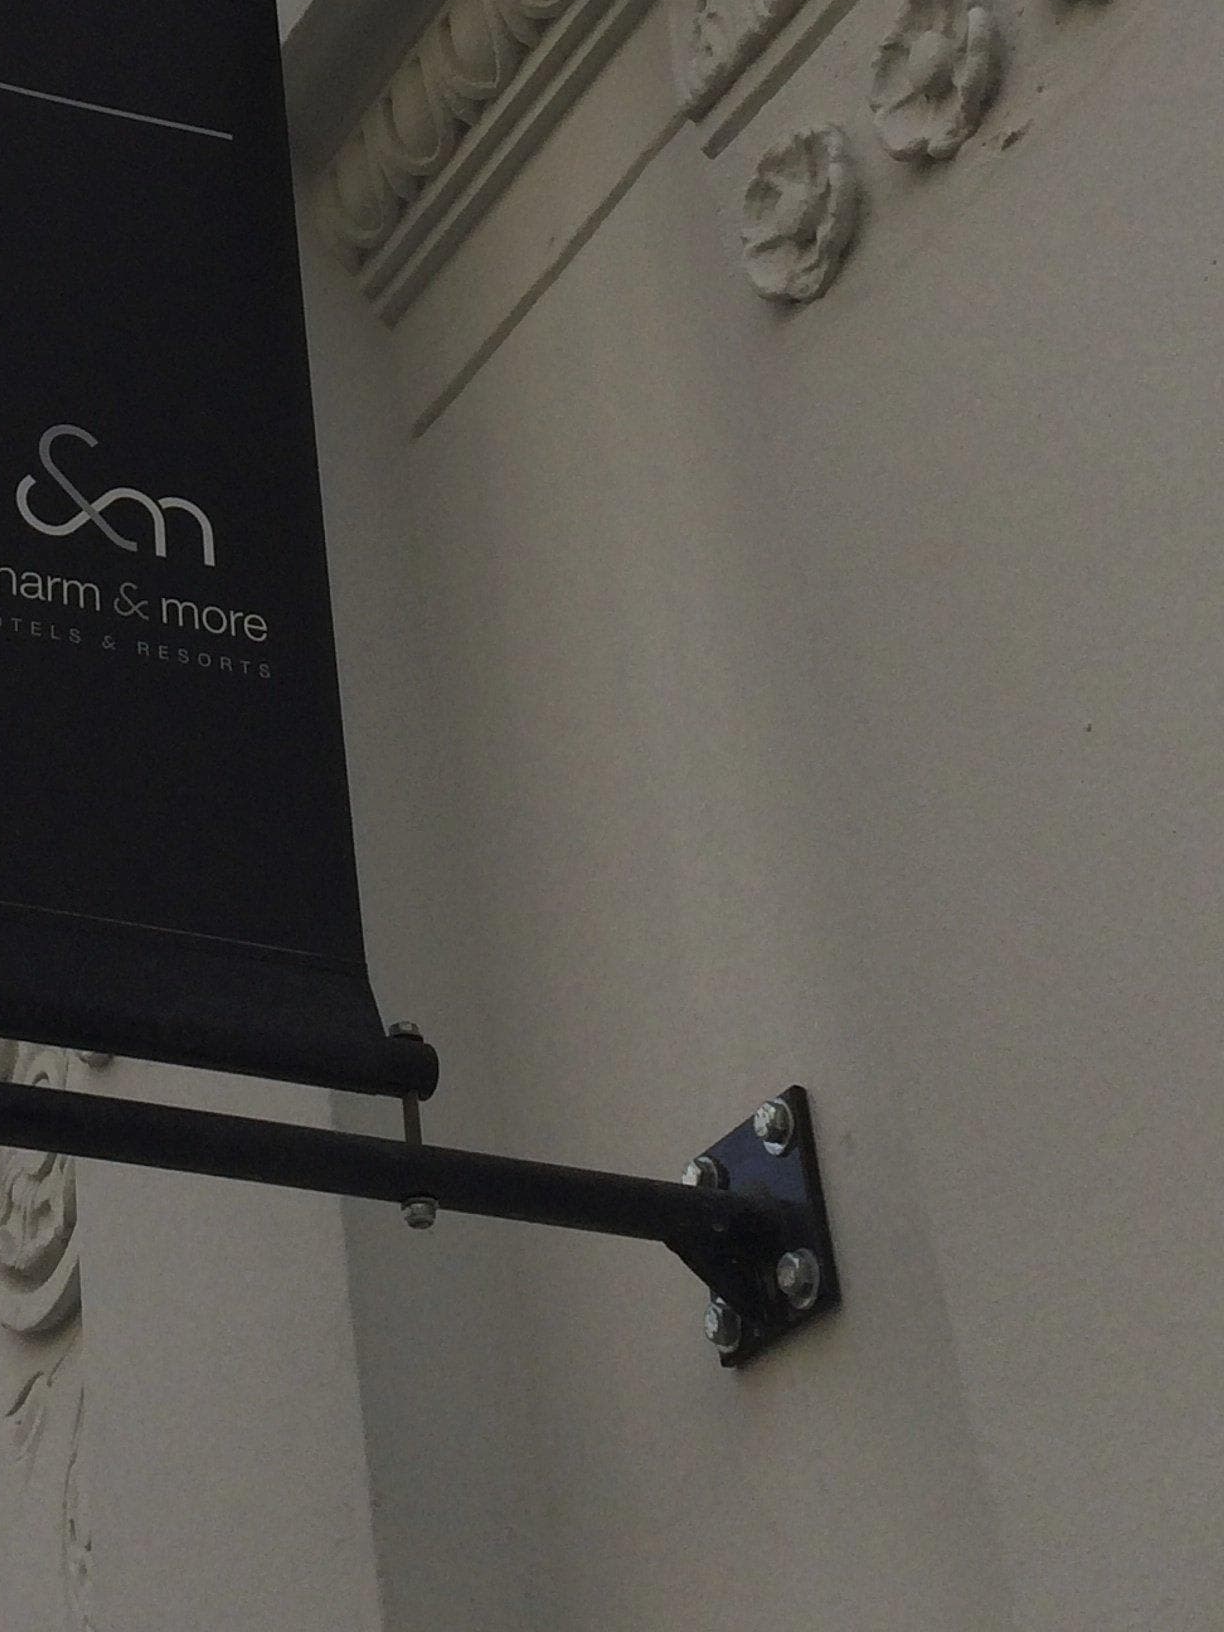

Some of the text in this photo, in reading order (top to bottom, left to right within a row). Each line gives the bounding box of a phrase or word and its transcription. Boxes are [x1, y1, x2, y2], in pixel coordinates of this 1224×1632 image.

[113, 581, 150, 621] &
[161, 596, 268, 642] more
[137, 640, 271, 679] RESORTS
